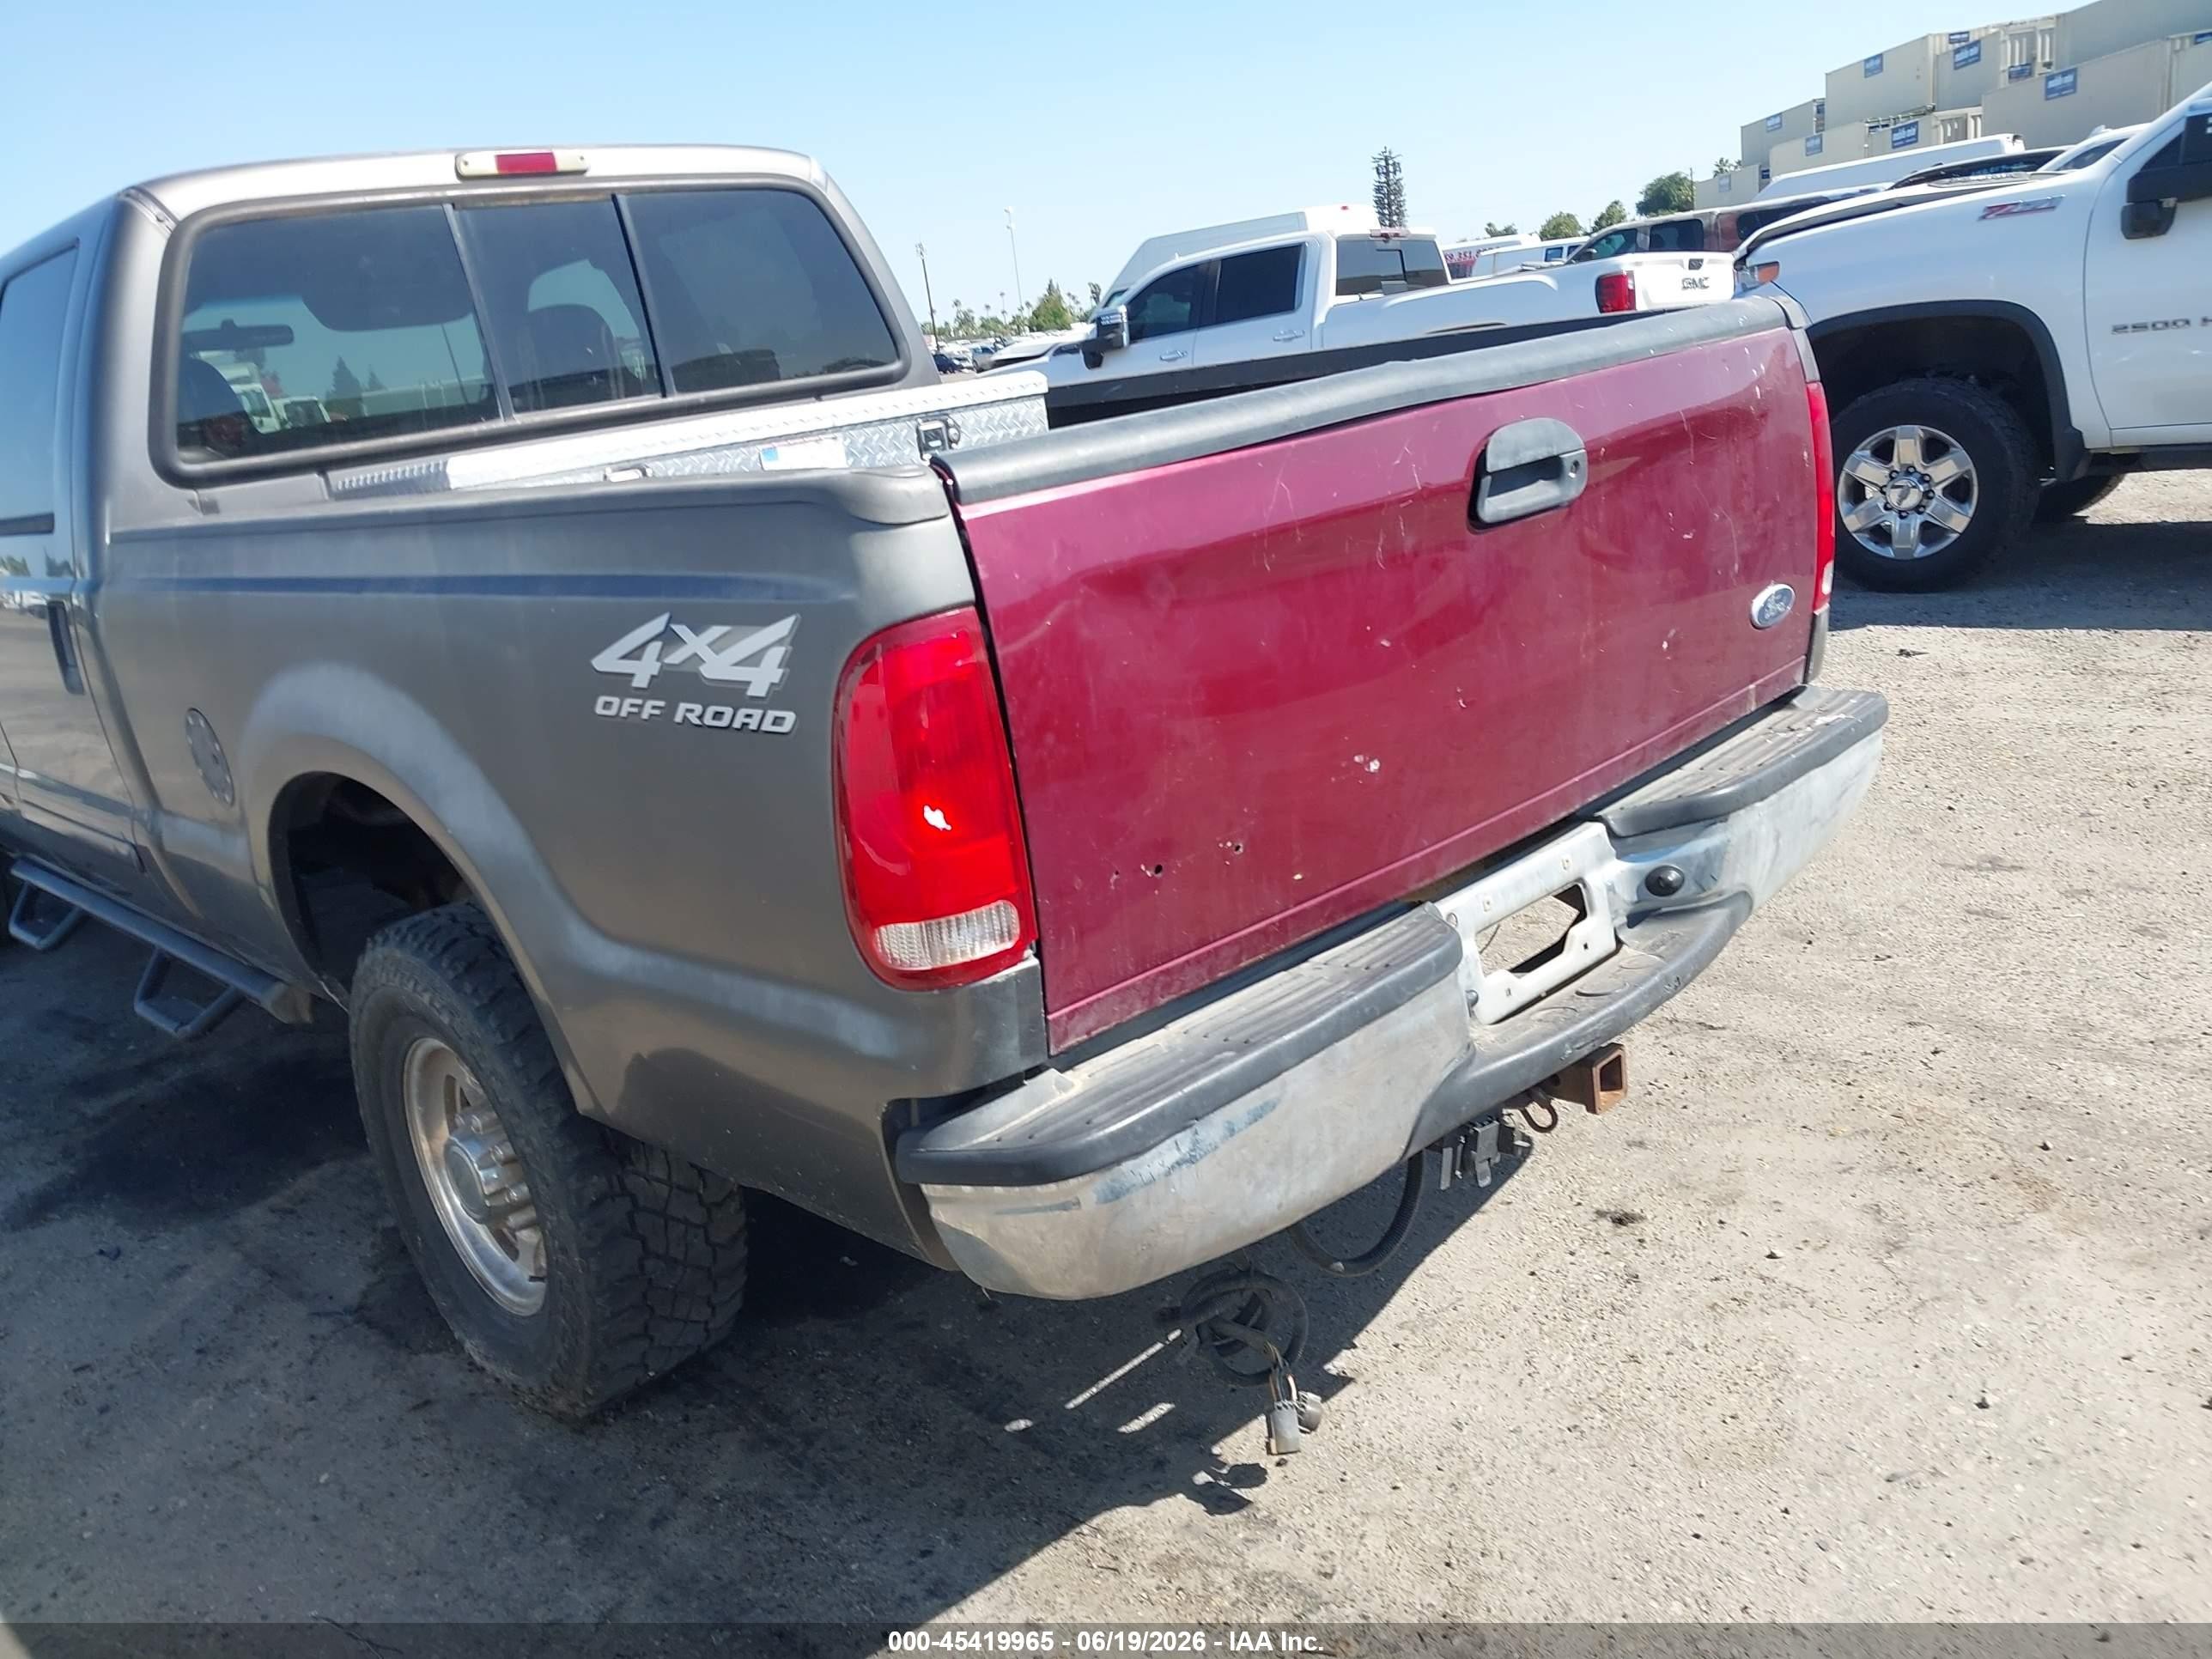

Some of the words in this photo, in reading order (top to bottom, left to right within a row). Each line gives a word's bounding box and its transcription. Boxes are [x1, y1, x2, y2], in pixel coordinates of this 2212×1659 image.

[1682, 276, 1710, 289] GMC
[2112, 319, 2190, 335] 2500
[594, 696, 665, 720] OFF
[674, 702, 797, 733] ROAD
